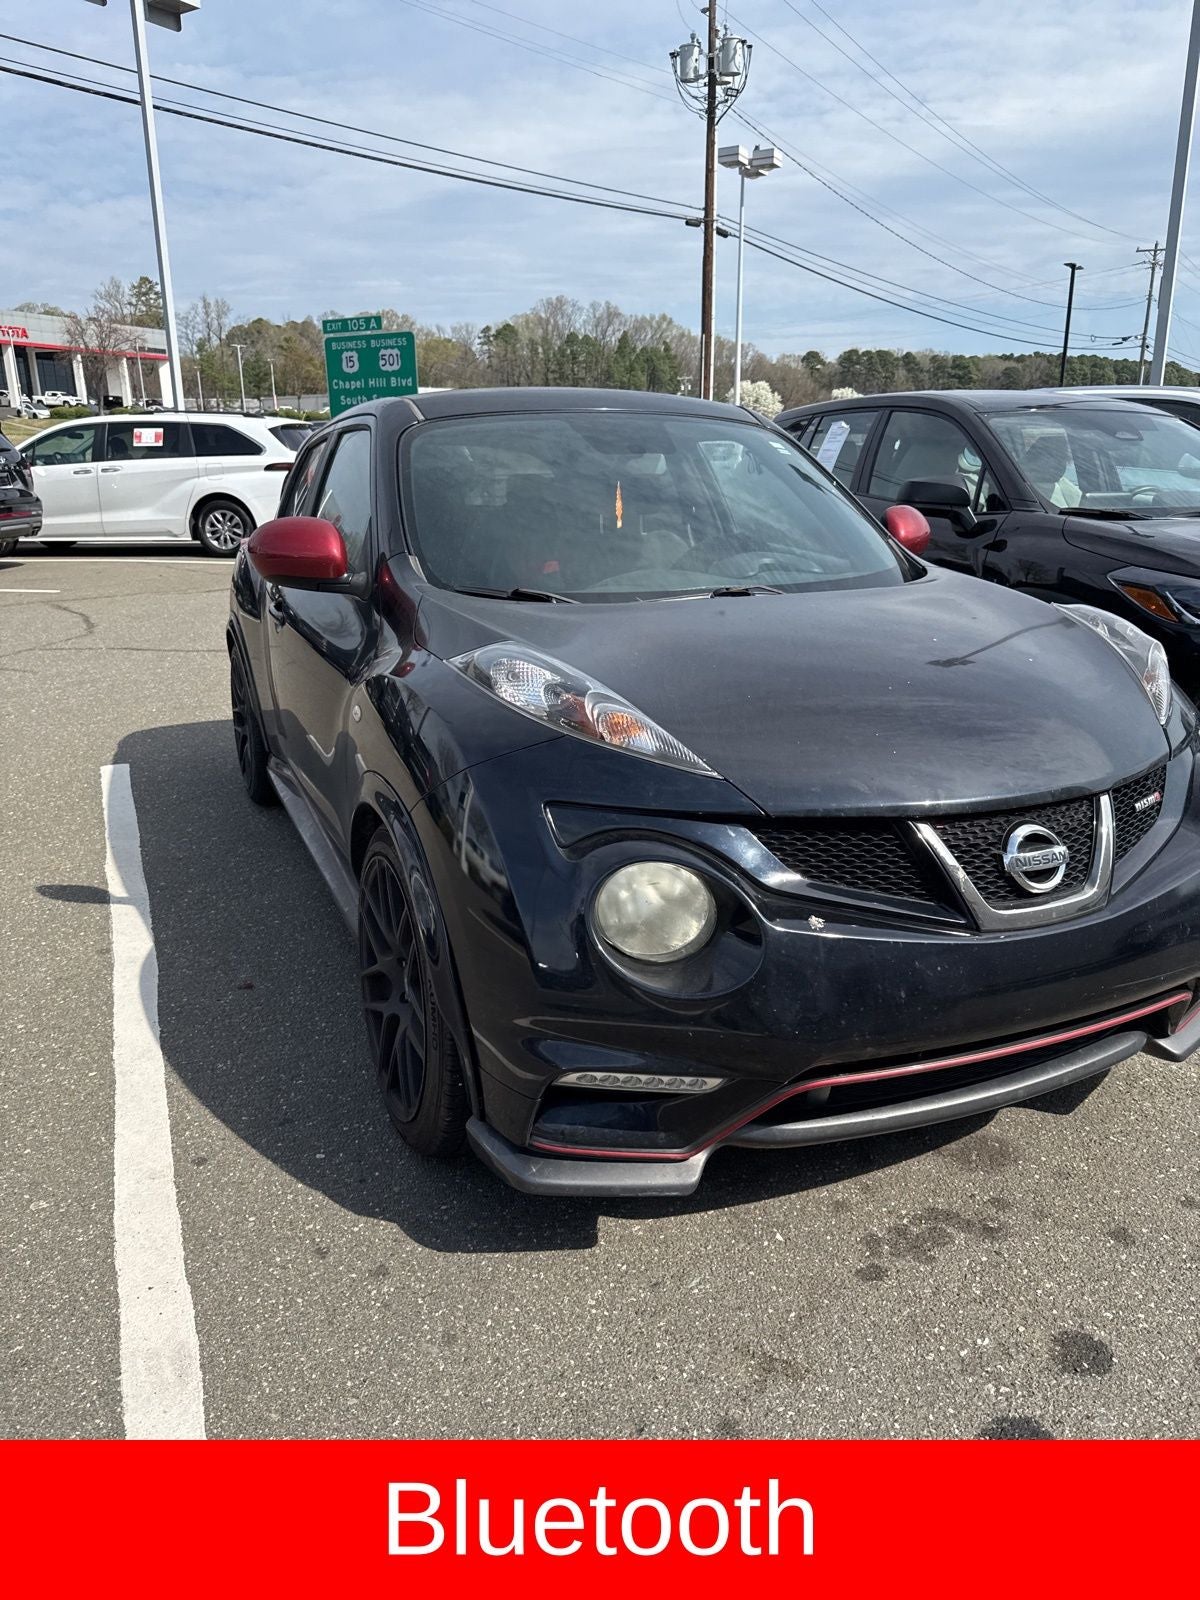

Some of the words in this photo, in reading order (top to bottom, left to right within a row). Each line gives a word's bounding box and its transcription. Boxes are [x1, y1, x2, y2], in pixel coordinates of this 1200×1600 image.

[327, 322, 342, 331] EXIT
[347, 319, 366, 330] 105
[369, 318, 378, 329] A
[331, 340, 367, 350] BUSINESS
[370, 337, 407, 347] BUSINESS
[345, 355, 355, 368] 15
[380, 353, 399, 367] 501
[332, 379, 364, 390] Chapel
[369, 377, 386, 388] Hill
[390, 377, 412, 387] Blvd
[340, 395, 367, 405] South
[1014, 850, 1068, 868] NISSAN
